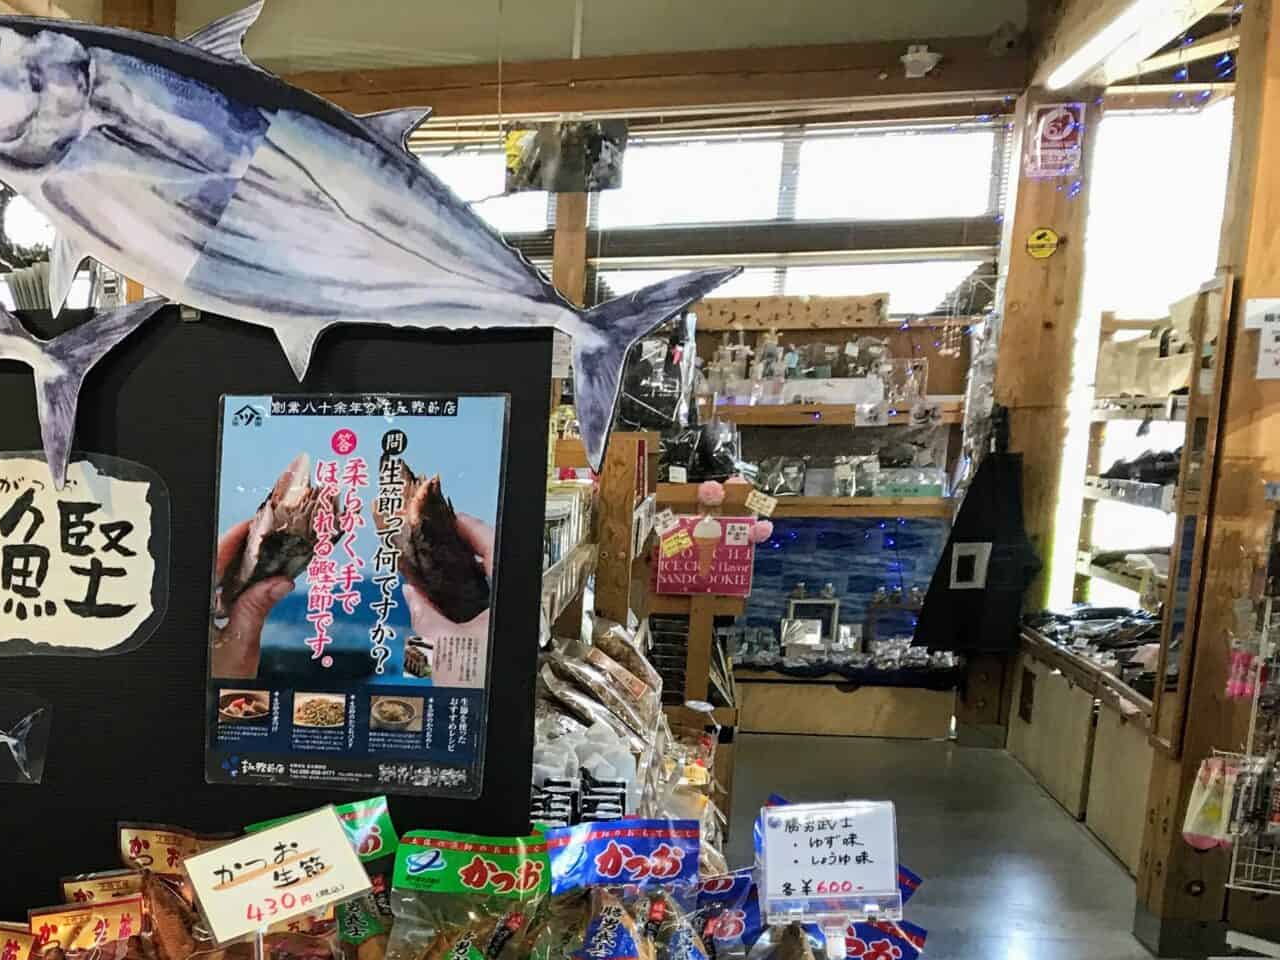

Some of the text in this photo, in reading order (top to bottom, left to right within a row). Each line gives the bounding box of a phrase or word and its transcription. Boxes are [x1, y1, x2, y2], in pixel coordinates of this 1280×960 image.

[335, 432, 354, 453] 答
[385, 432, 404, 452] 問
[809, 833, 865, 849] ゆず味
[213, 841, 299, 885] かつお
[595, 839, 685, 880] かつお
[811, 851, 874, 867] しょうゆ味
[273, 856, 325, 889] 生節
